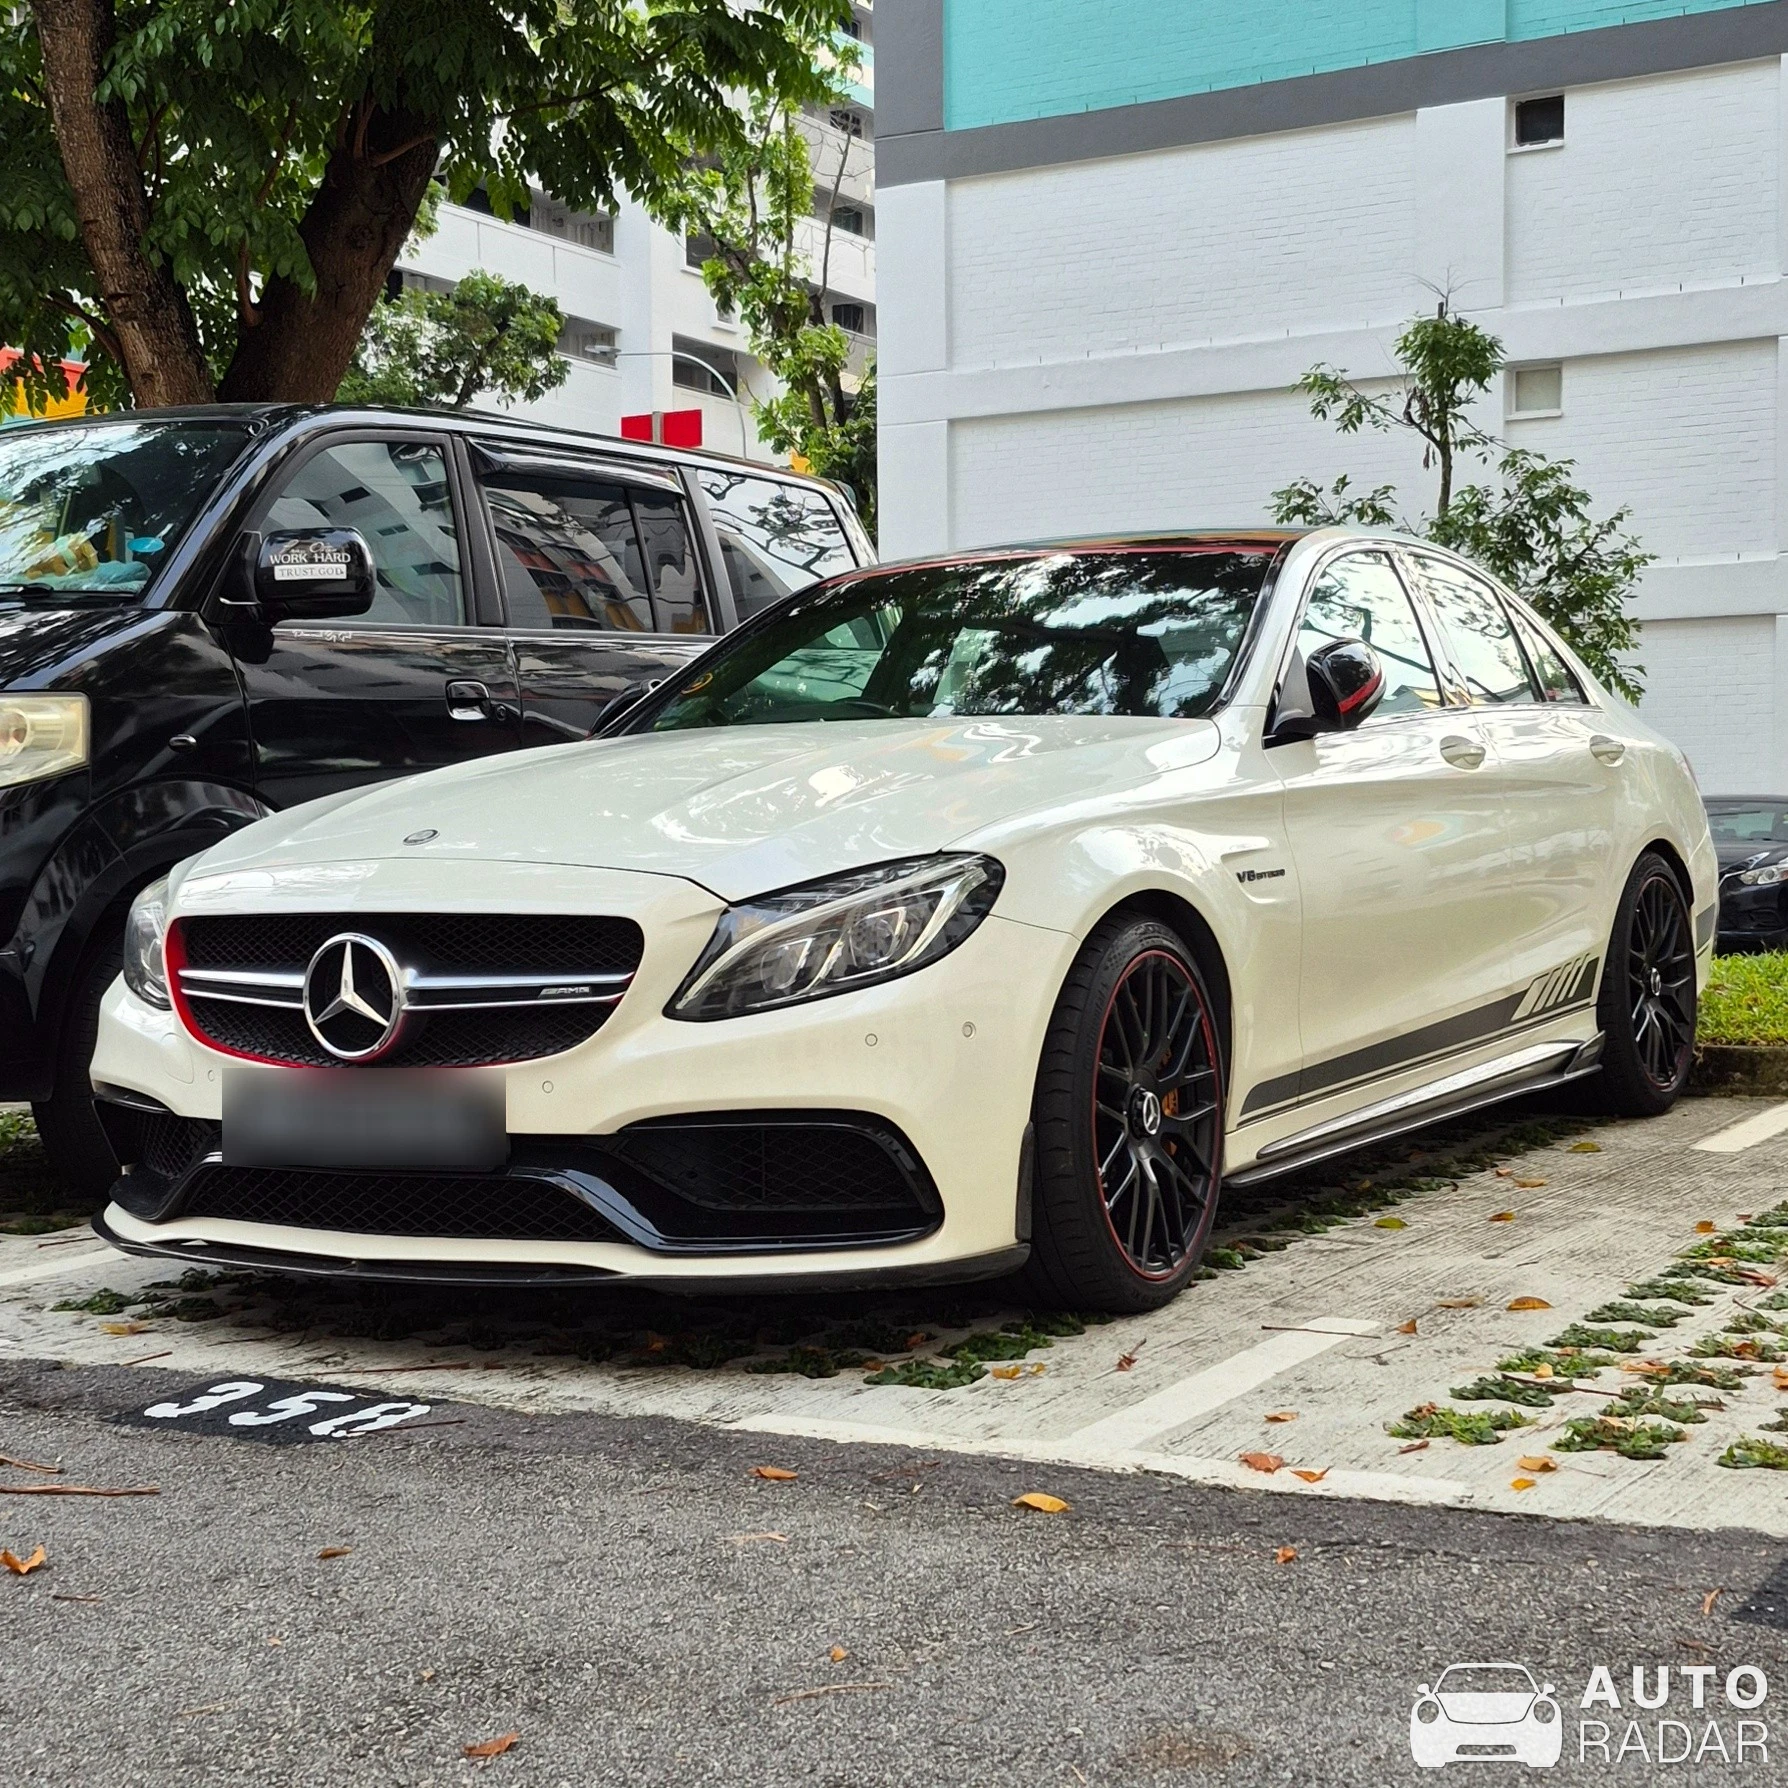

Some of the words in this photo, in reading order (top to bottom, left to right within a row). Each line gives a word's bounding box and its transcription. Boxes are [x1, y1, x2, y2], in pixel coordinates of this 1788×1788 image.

[270, 554, 308, 564] WORK
[314, 552, 351, 563] HARD
[279, 568, 315, 578] TRUST
[144, 1381, 431, 1438] 358
